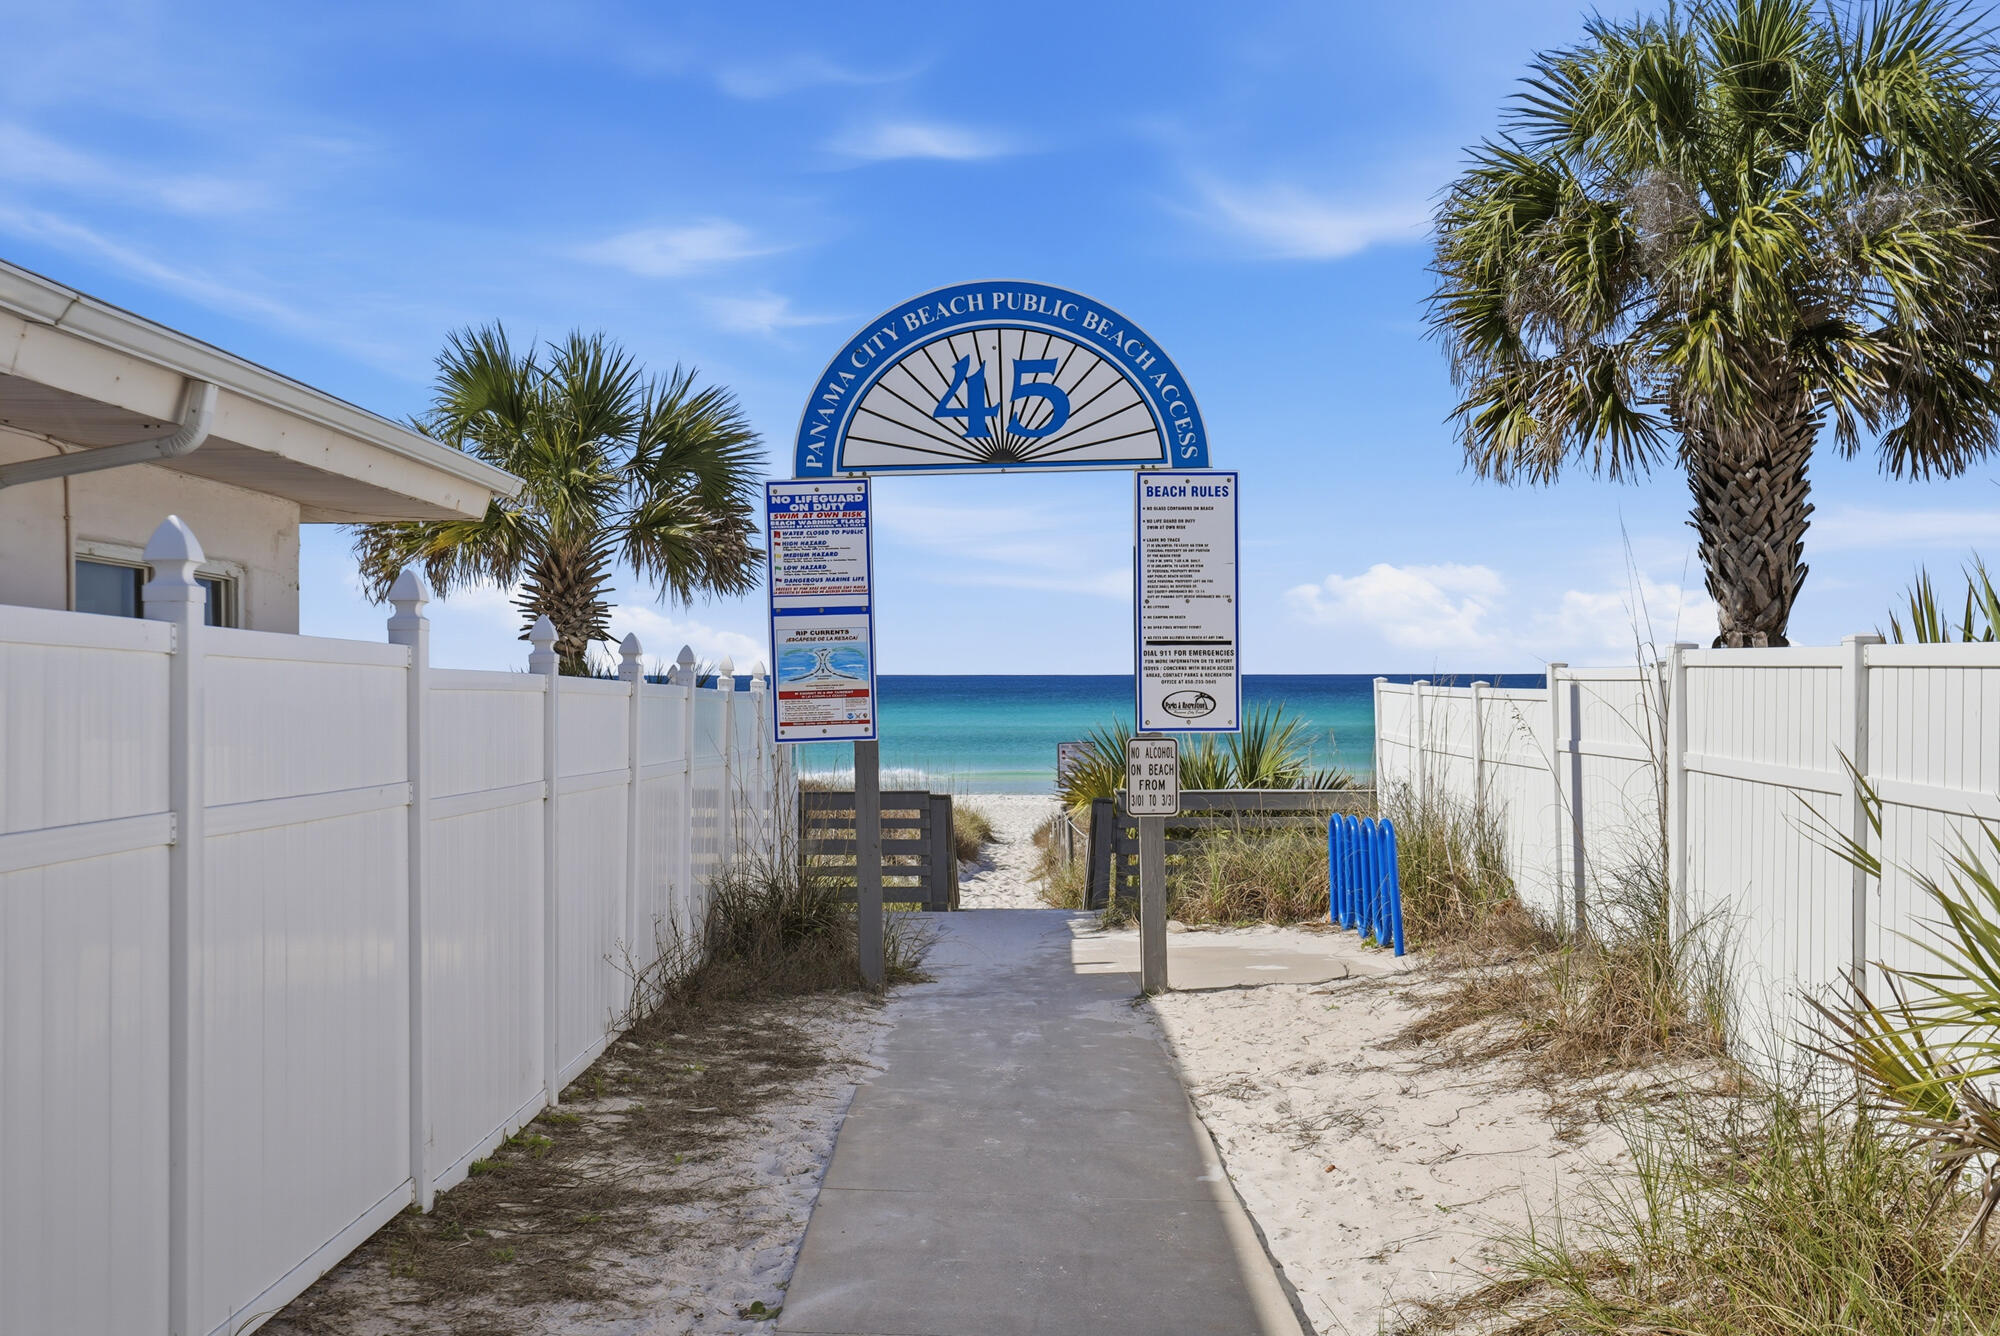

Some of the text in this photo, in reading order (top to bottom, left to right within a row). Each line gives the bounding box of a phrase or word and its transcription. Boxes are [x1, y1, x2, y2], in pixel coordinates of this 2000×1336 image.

[806, 292, 1198, 468] PANAMA CITY BEACH PUBLIC BEACH ACCESS
[932, 353, 1071, 440] 45
[1146, 485, 1229, 497] BEACH RULES
[772, 495, 863, 504] NO LIFEGUARD
[814, 503, 846, 511] DUTY
[1130, 746, 1174, 759] NO ALCOHOL
[1131, 763, 1174, 776] ON BEACH
[1139, 779, 1166, 791] FROM
[1131, 794, 1174, 806] 3/01 TO 3/31
